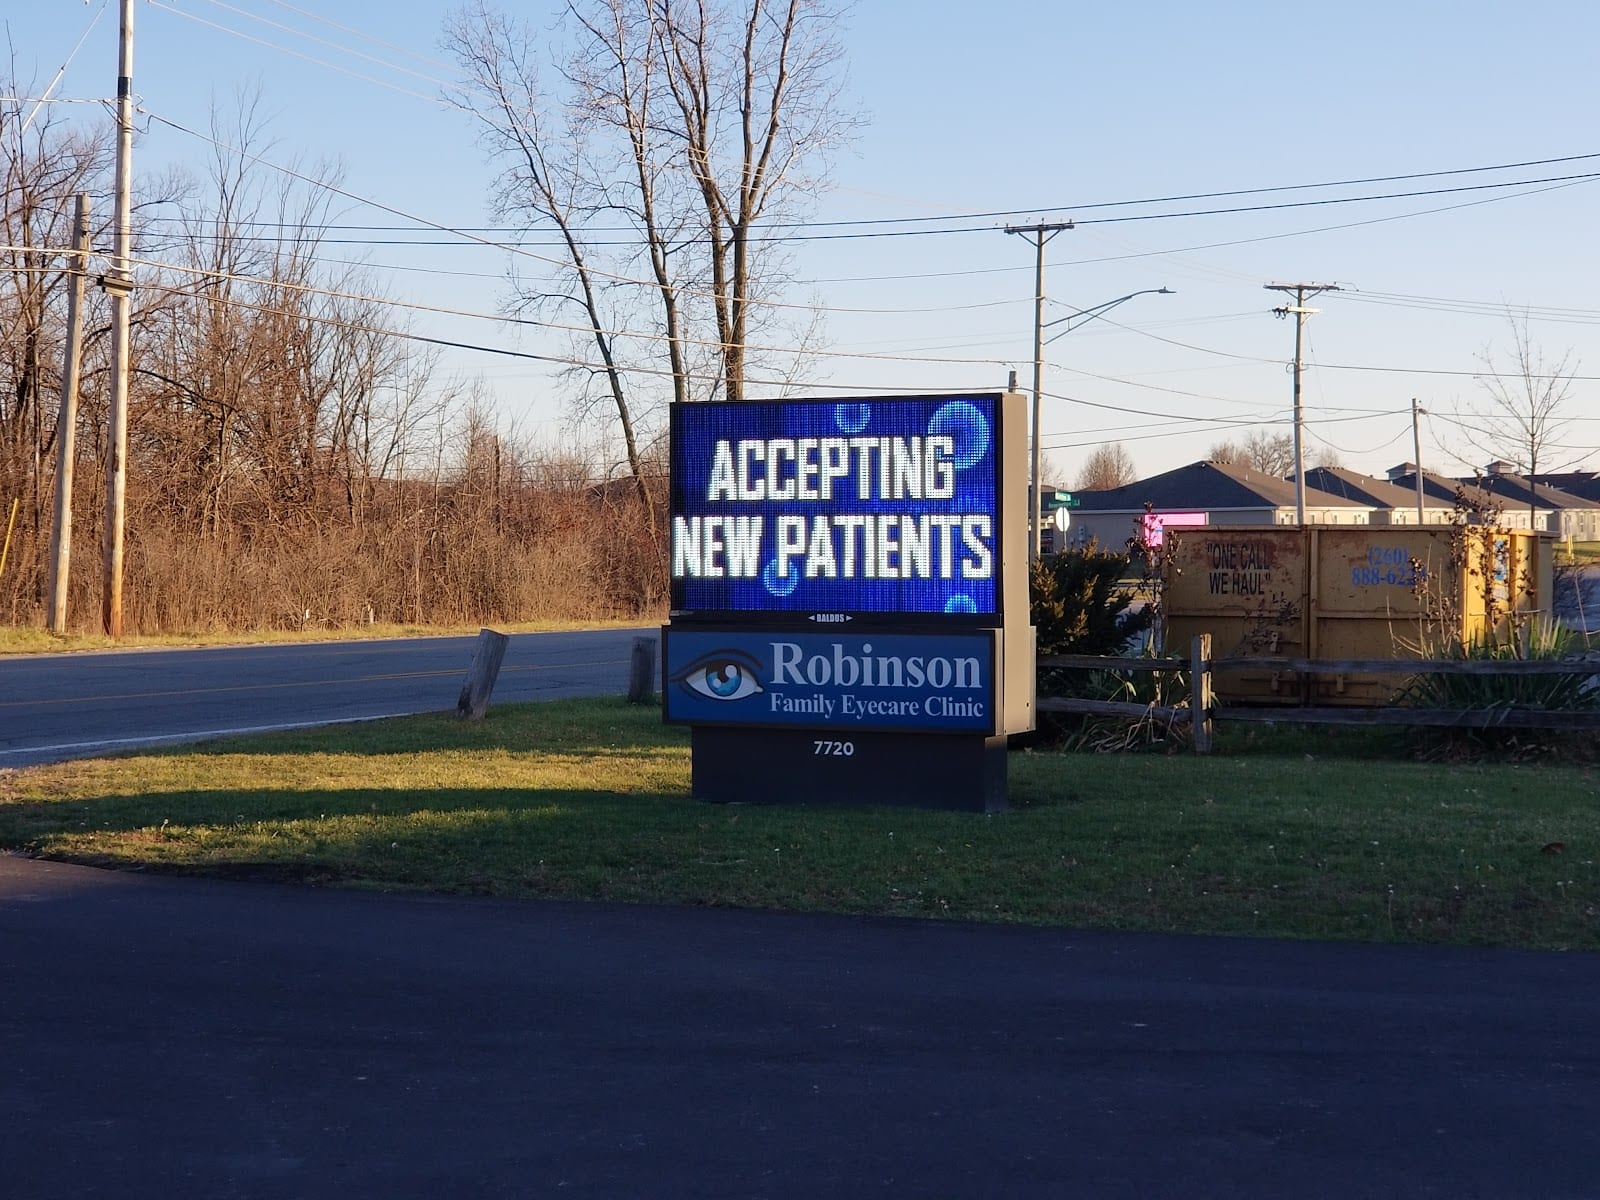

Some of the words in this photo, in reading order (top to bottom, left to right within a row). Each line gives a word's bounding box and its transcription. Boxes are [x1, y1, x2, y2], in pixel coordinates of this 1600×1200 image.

[709, 436, 954, 501] ACCEPTING
[674, 515, 762, 577] NEW
[777, 514, 992, 578] PATIENTS
[1240, 543, 1270, 570] CALL
[1209, 572, 1228, 595] WE
[769, 642, 983, 688] Robinson
[770, 692, 836, 719] Family
[841, 694, 920, 719] Eyecare
[924, 696, 984, 717] Clinic
[813, 741, 854, 756] 7720
